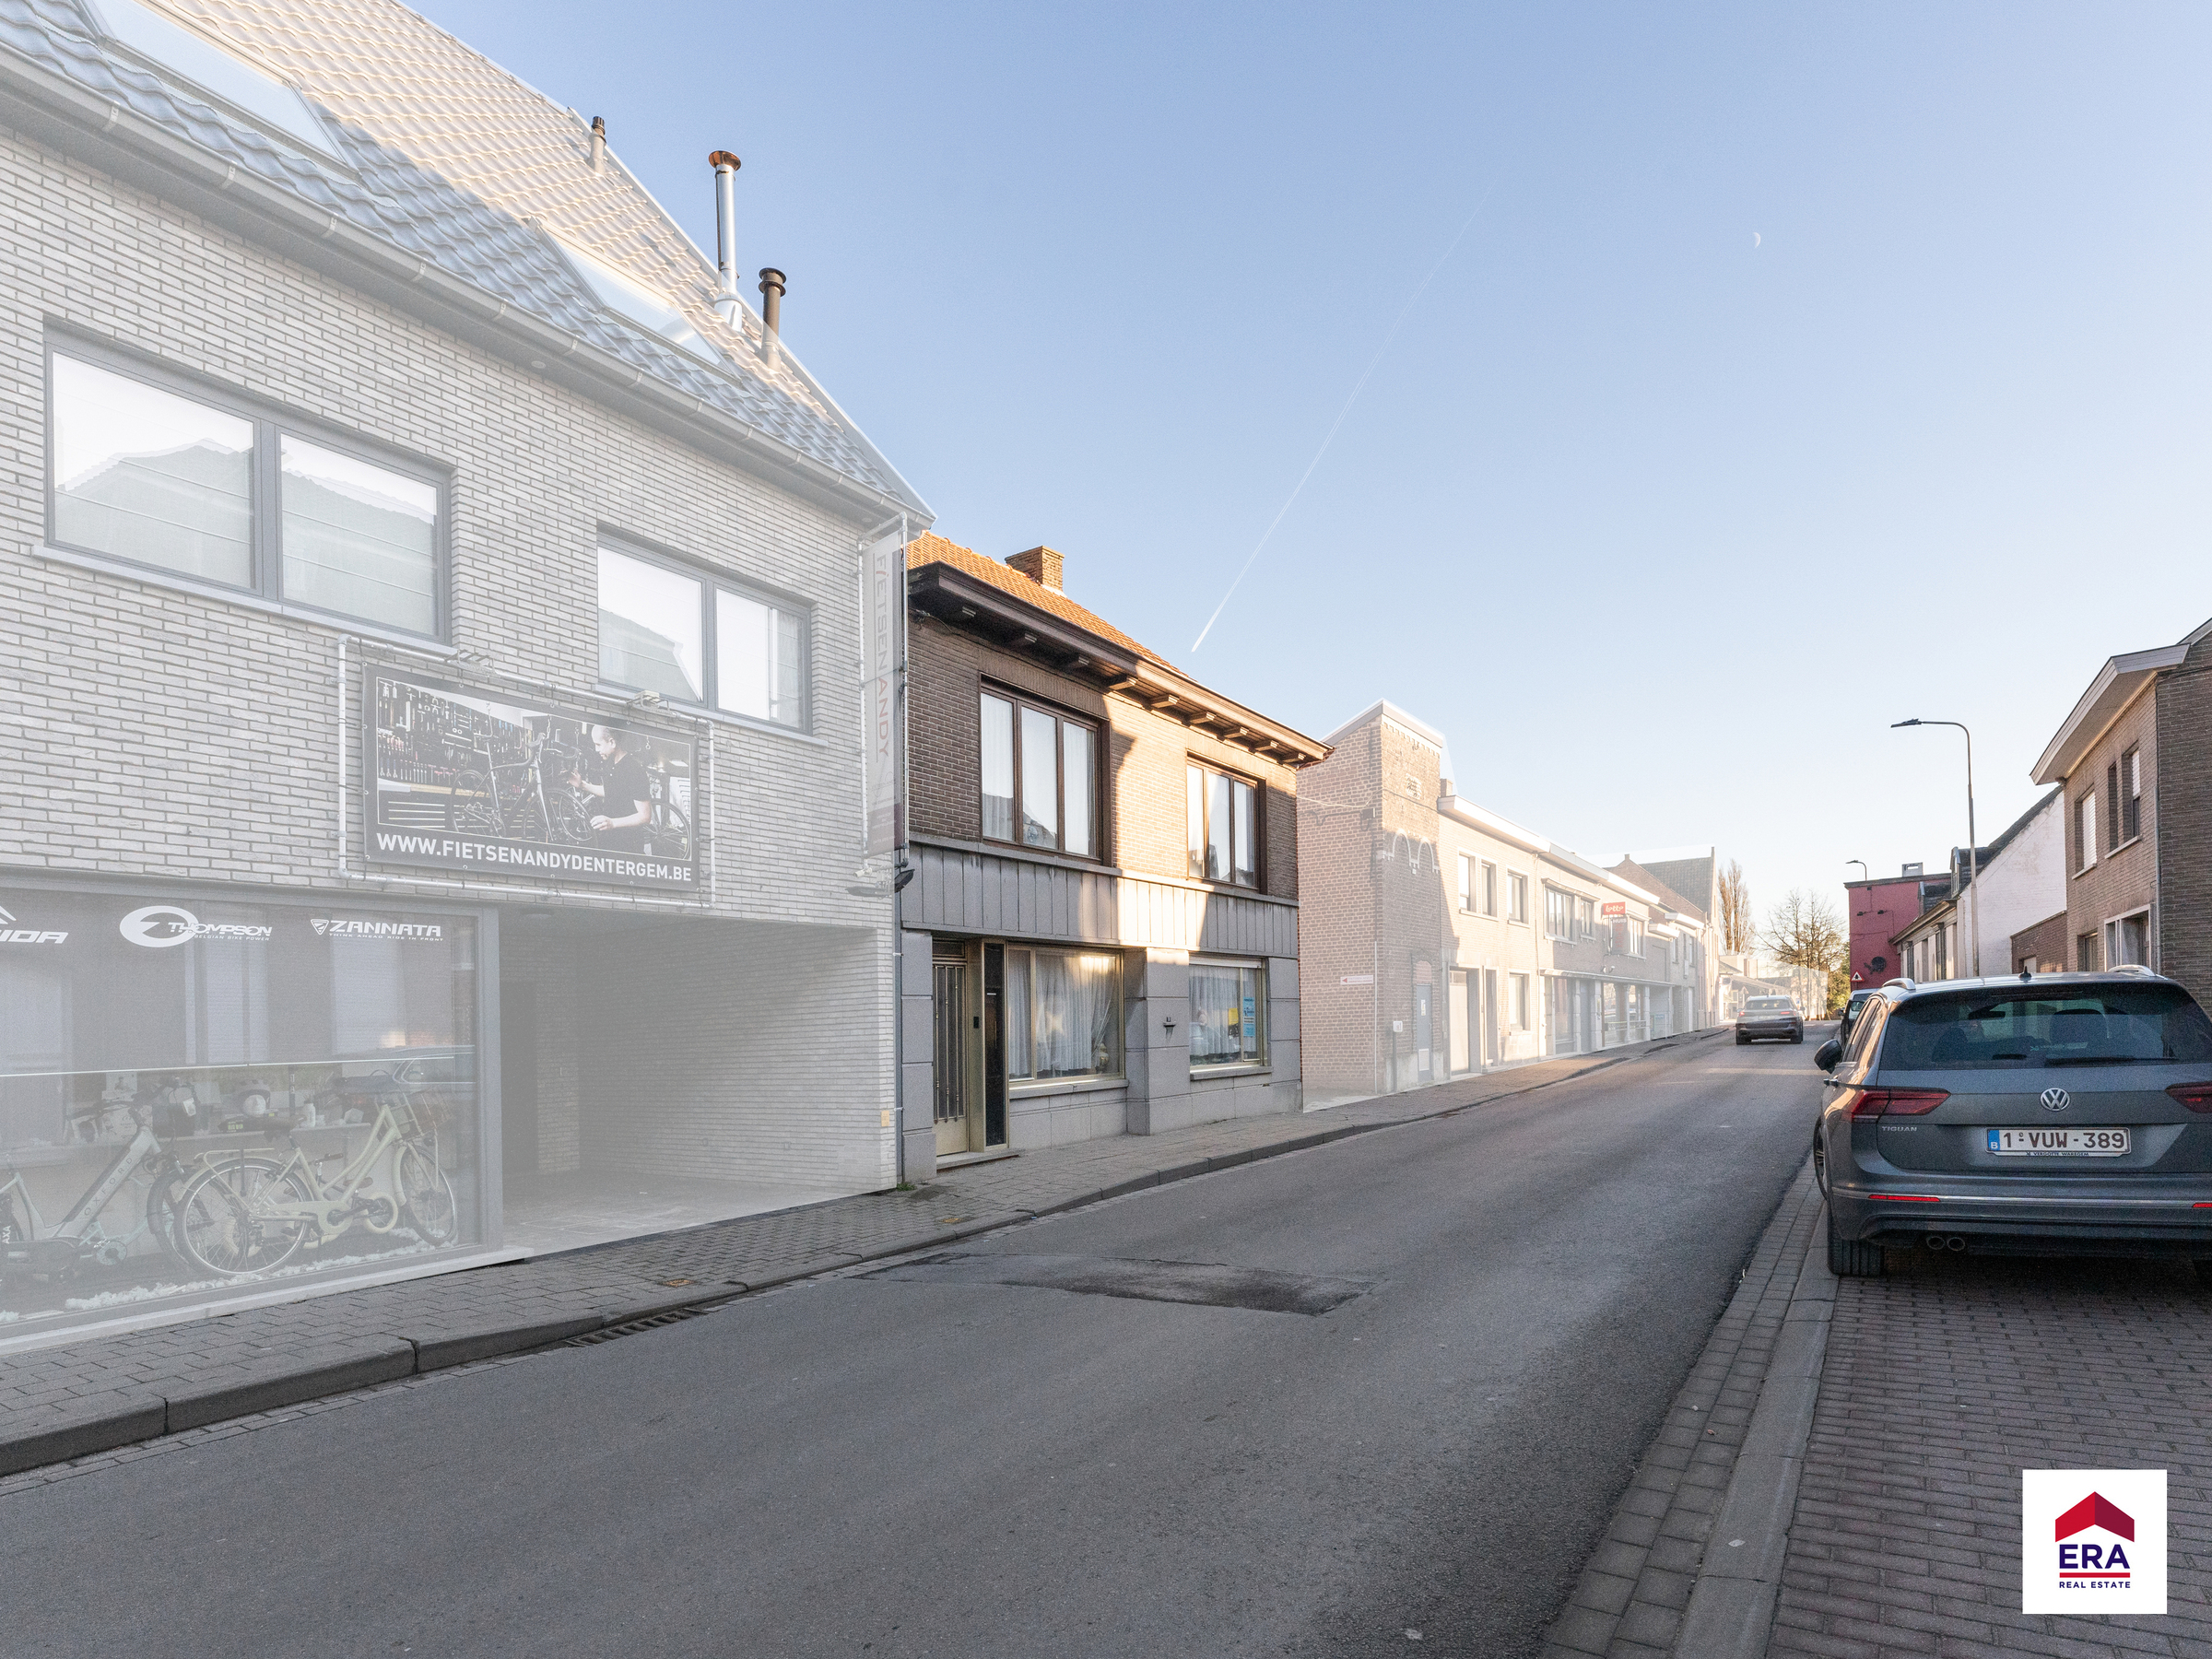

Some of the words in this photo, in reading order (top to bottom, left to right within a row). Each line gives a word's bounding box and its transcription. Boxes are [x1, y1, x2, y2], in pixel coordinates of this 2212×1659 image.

[877, 678, 889, 758] ANDY
[377, 832, 692, 882] WWW.FIETSENANDYDENTERGEM.BE
[0, 929, 68, 944] IDA
[168, 922, 272, 936] THOMPSON
[329, 920, 441, 937] ZANNATA
[1990, 1141, 1998, 1149] B
[84, 1157, 133, 1217] OXFORD
[2, 1225, 12, 1244] AXA
